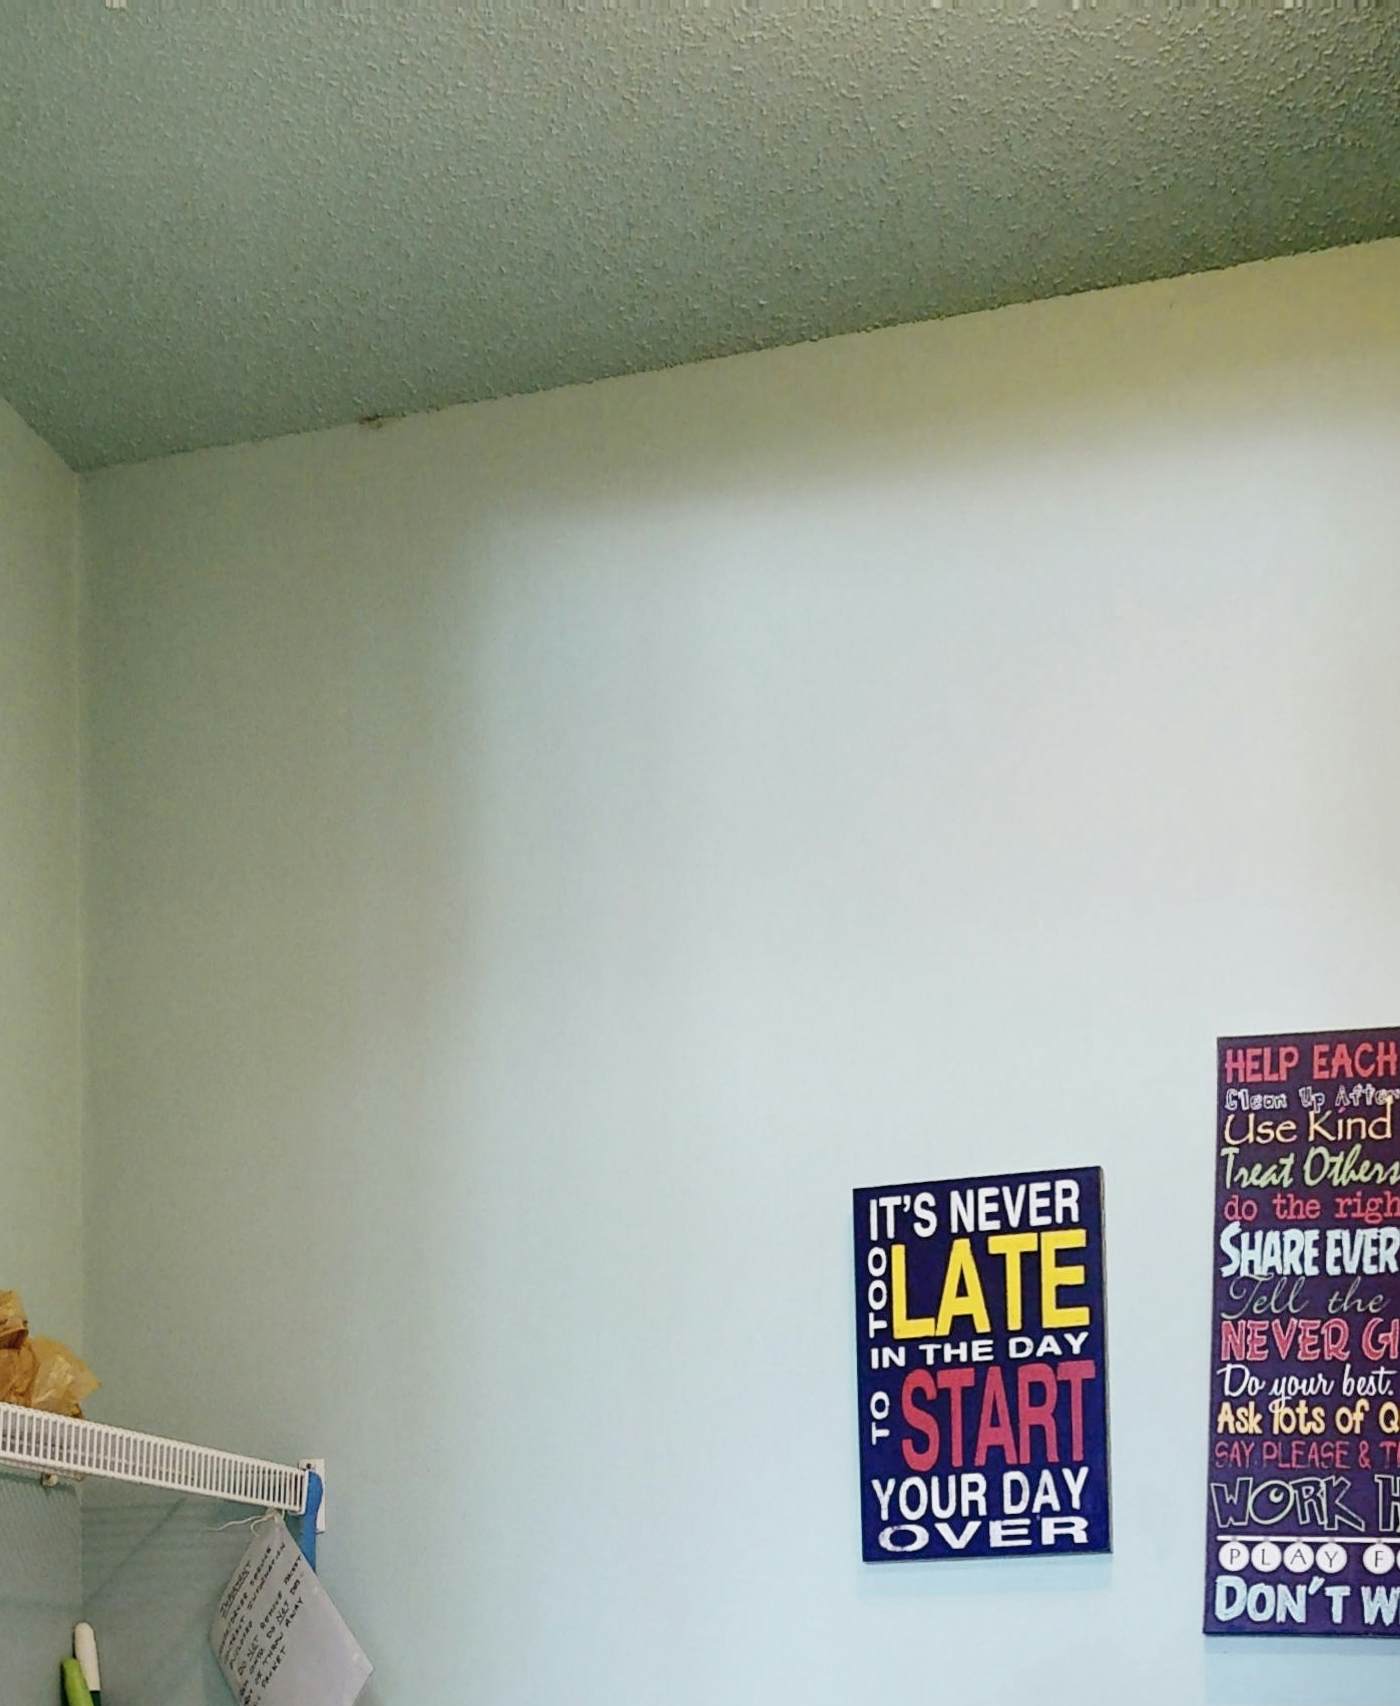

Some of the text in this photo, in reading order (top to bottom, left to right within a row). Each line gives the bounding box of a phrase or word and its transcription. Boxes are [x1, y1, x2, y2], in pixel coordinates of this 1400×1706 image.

[1224, 1041, 1398, 1083] HELP EACH
[1224, 1088, 1287, 1111] Clean
[1299, 1087, 1325, 1113] Up
[1224, 1095, 1392, 1145] Use Kind
[1220, 1144, 1400, 1189] Treat Others
[870, 1179, 1080, 1241] IT'S NEVER
[1224, 1195, 1258, 1220] do
[1272, 1193, 1320, 1220] the
[1220, 1221, 1400, 1278] SHARE EVER
[868, 1247, 888, 1338] TOO
[890, 1229, 1090, 1340] LATE
[1220, 1272, 1392, 1321] Tell the
[870, 1331, 1089, 1369] IN THE DAY
[1220, 1318, 1349, 1361] NEVER
[1217, 1363, 1397, 1415] Do your best.
[870, 1391, 890, 1445] TO
[901, 1360, 1096, 1472] START
[1217, 1401, 1263, 1435] Ask
[1272, 1404, 1325, 1435] lots
[1335, 1398, 1369, 1435] of
[1215, 1440, 1255, 1469] SAY
[1262, 1440, 1351, 1469] PLEASE
[1359, 1440, 1371, 1469] &
[872, 1466, 1089, 1521] YOUR DAY
[1211, 1476, 1365, 1532] WORK
[878, 1515, 1089, 1552] OVER
[1225, 1545, 1341, 1571] PLAY
[1215, 1575, 1351, 1624] DON'T
